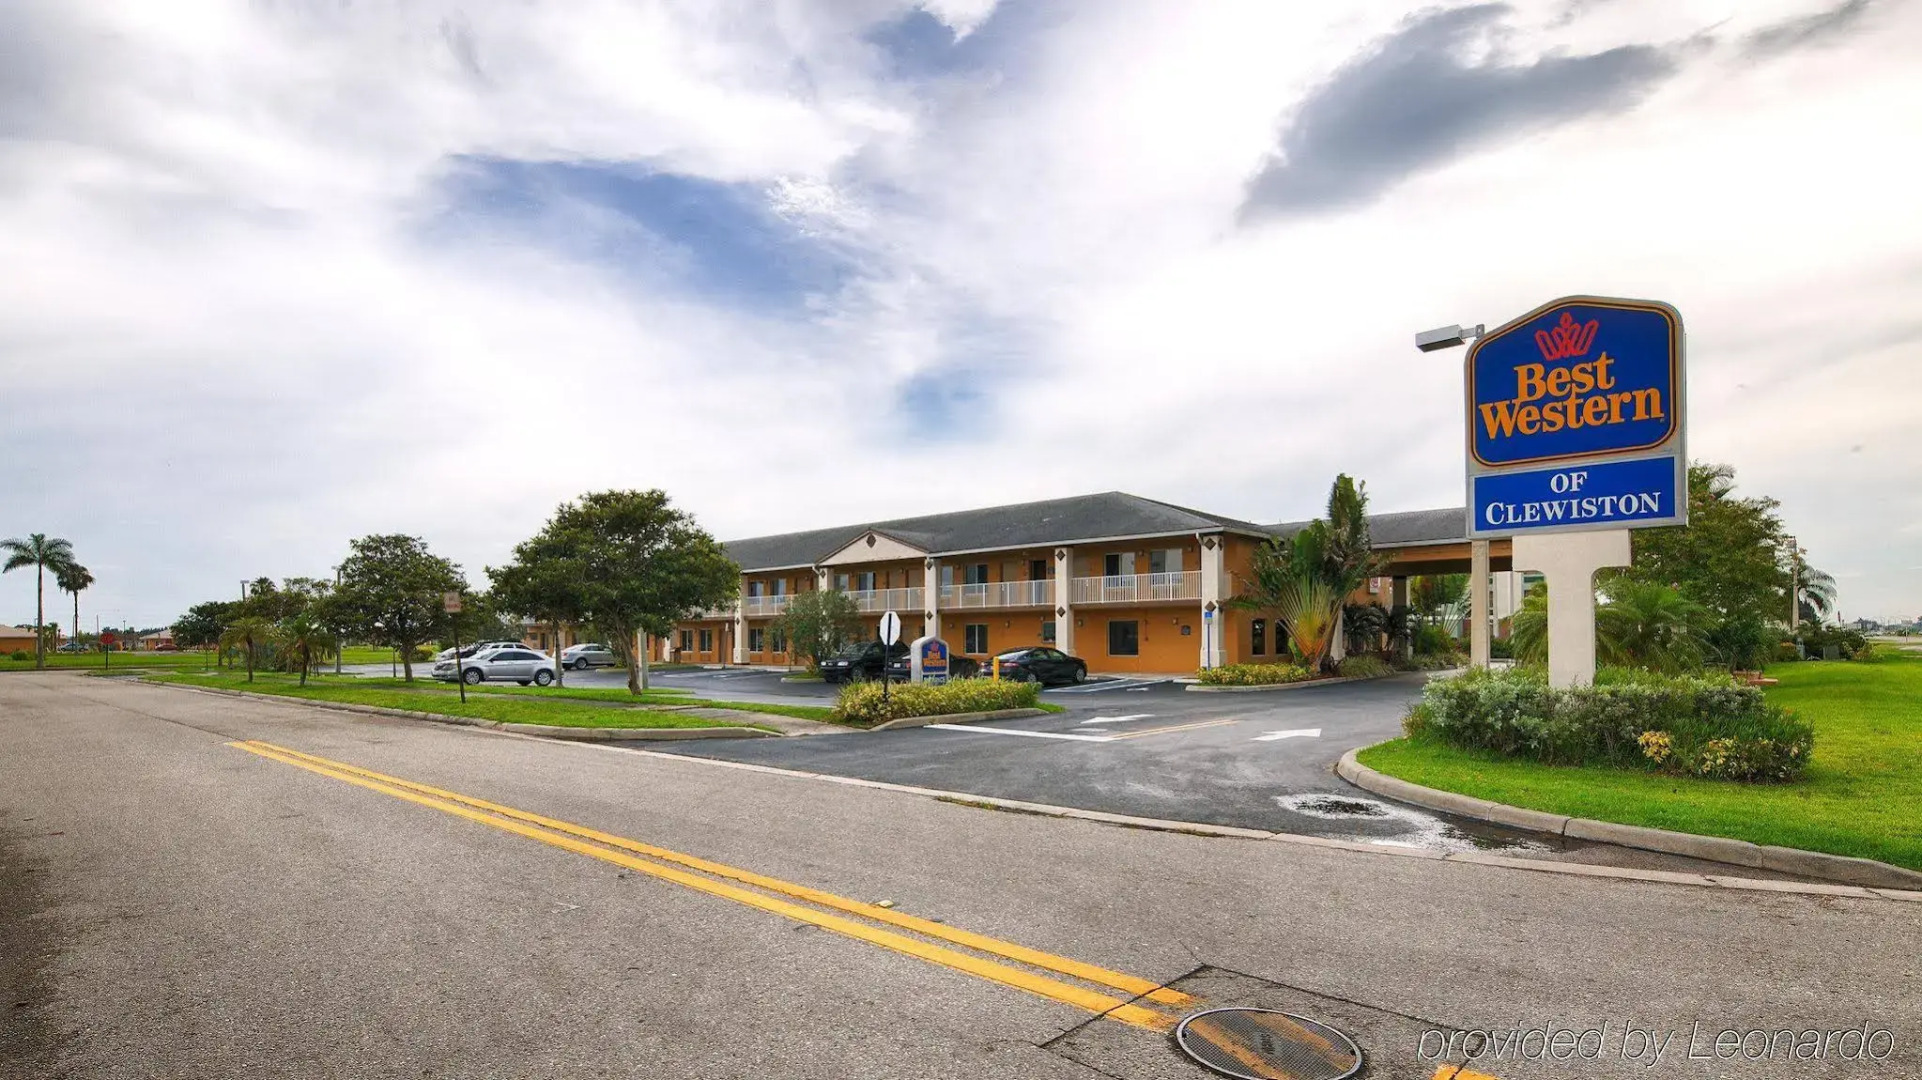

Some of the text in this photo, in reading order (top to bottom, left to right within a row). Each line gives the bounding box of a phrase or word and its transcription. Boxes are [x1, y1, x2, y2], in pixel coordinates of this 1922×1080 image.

[1514, 352, 1614, 401] Best
[1479, 387, 1664, 439] Western
[1550, 472, 1587, 493] OF
[1485, 492, 1661, 525] CLEWISTON
